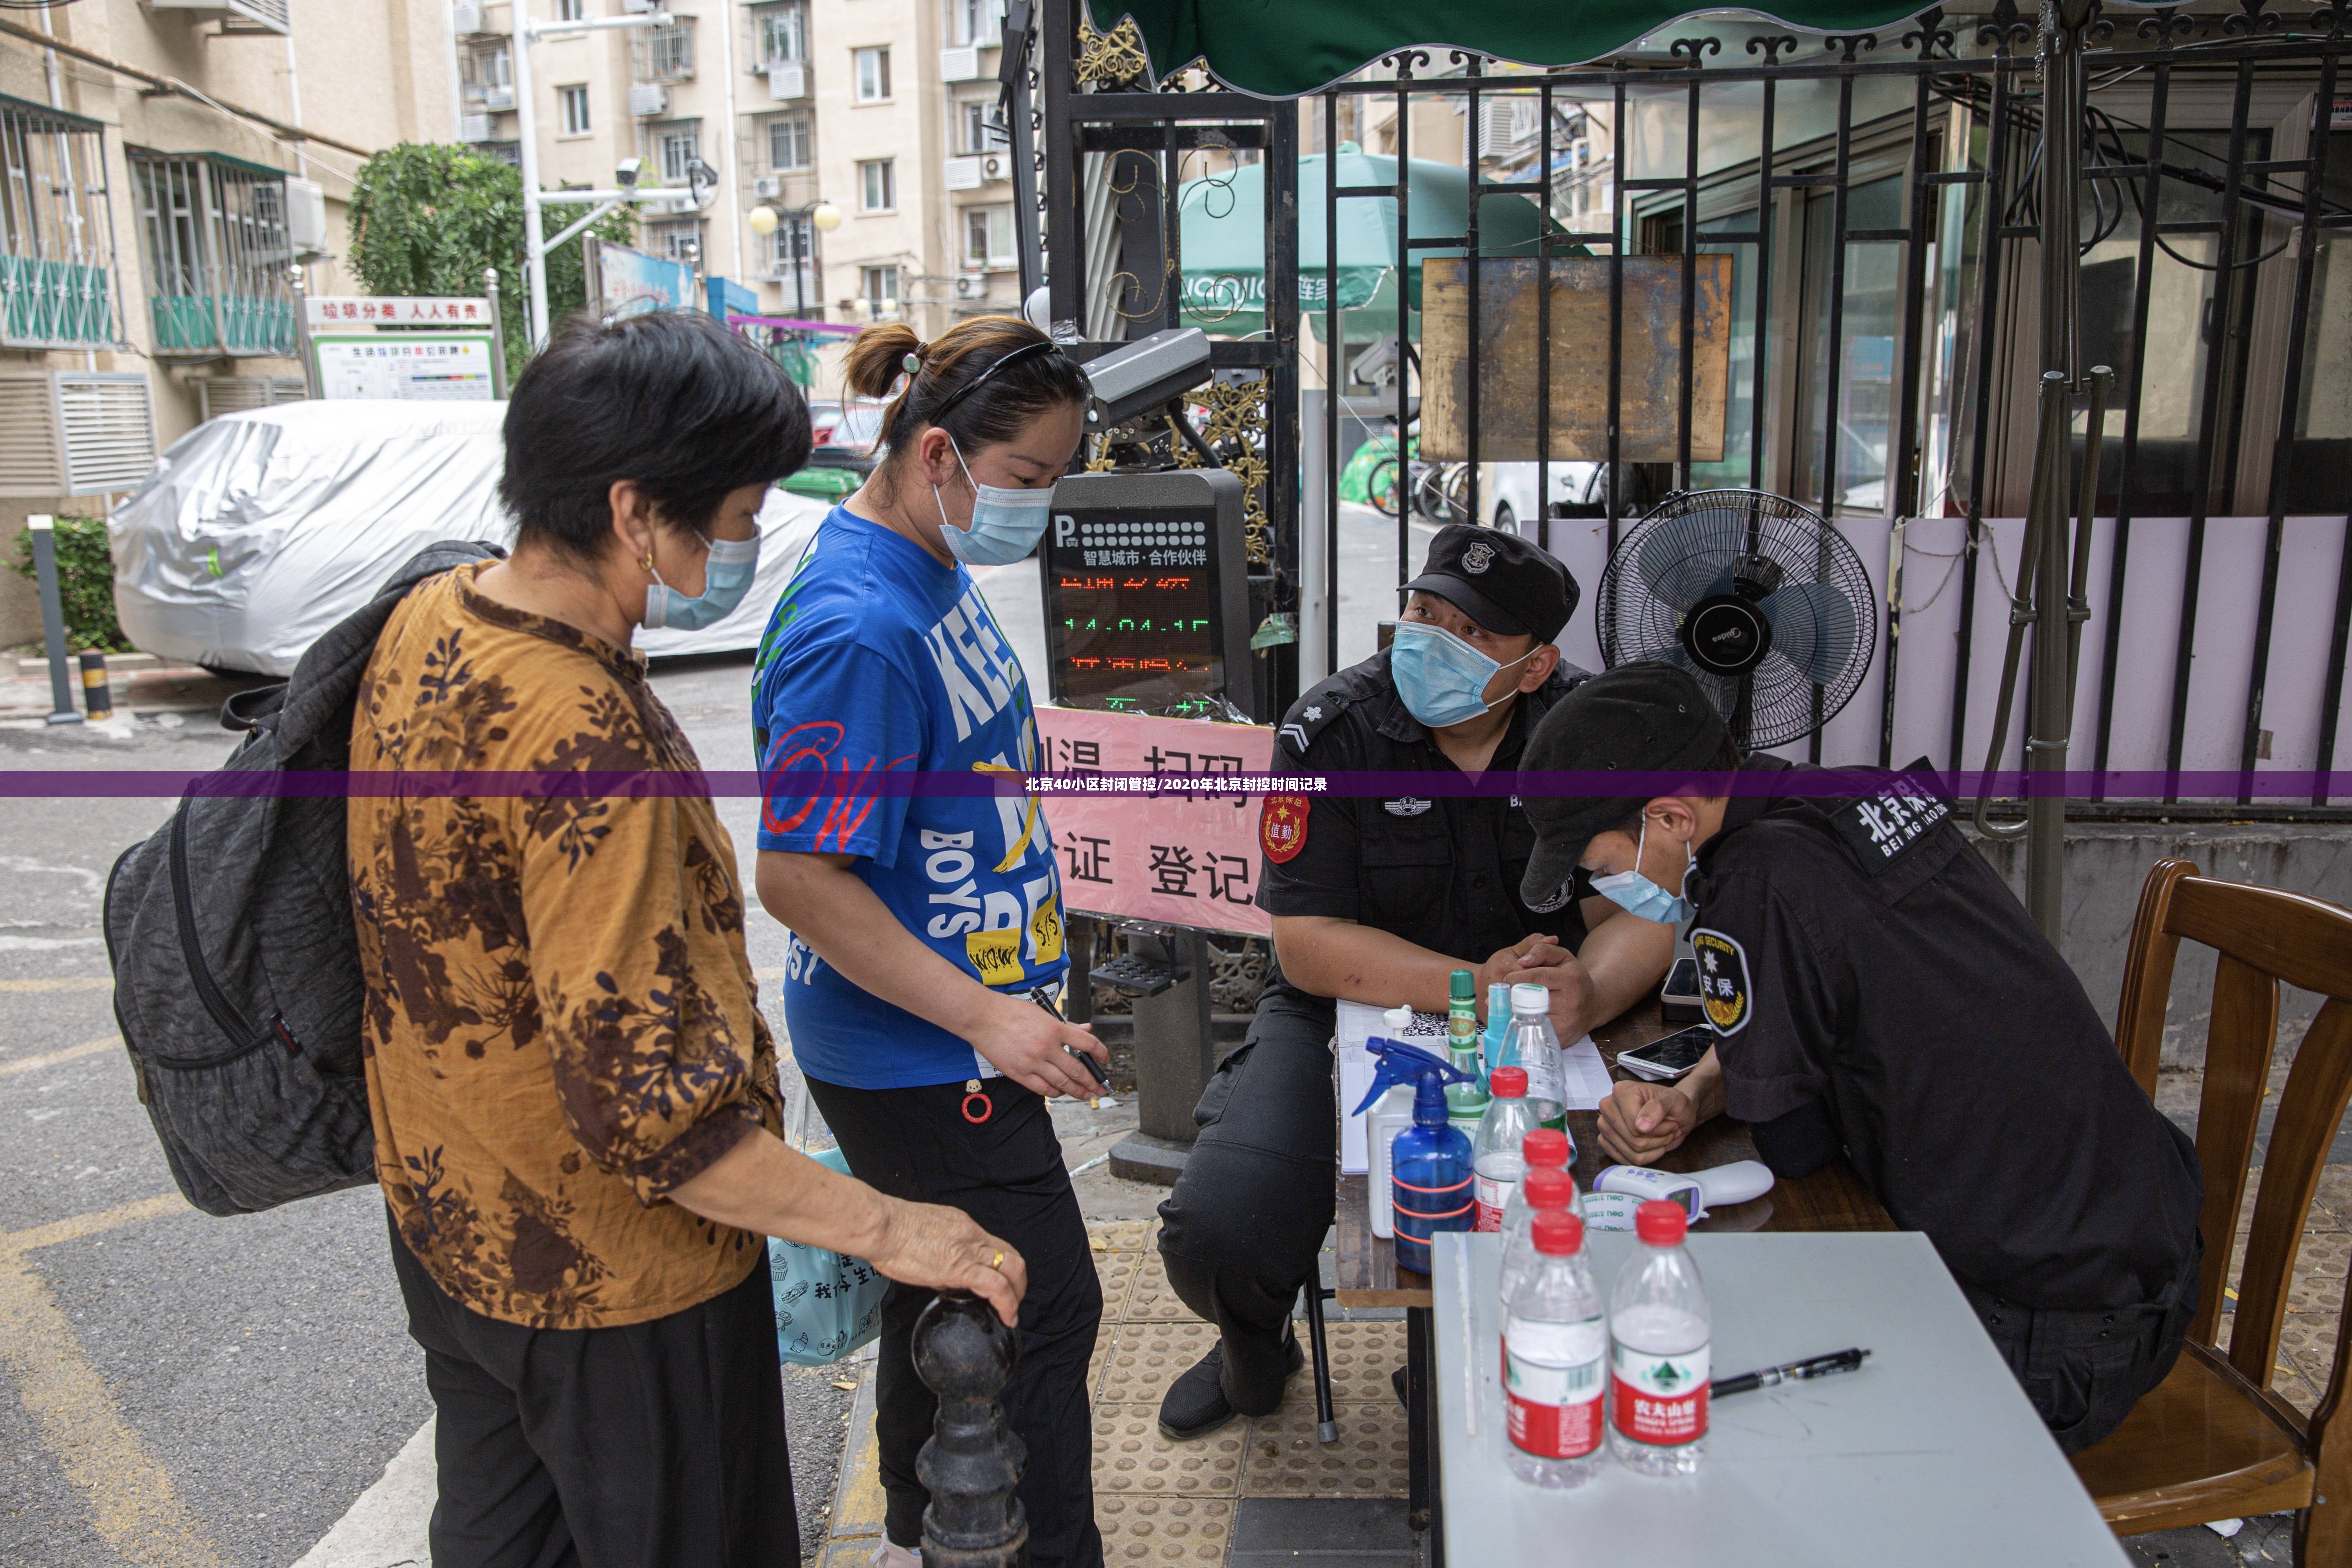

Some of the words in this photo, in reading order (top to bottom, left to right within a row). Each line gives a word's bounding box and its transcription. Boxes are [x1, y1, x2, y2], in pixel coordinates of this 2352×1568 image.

[323, 303, 396, 319] 垃圾分类
[411, 304, 477, 320] 人人有责
[1083, 549, 1207, 567] 智慧城市·合作伙伴
[1270, 823, 1293, 840] 值勤
[1054, 832, 1113, 884] 证
[1149, 845, 1254, 906] 登记
[921, 829, 980, 938] BOYS
[1705, 935, 1735, 956] SECURITY
